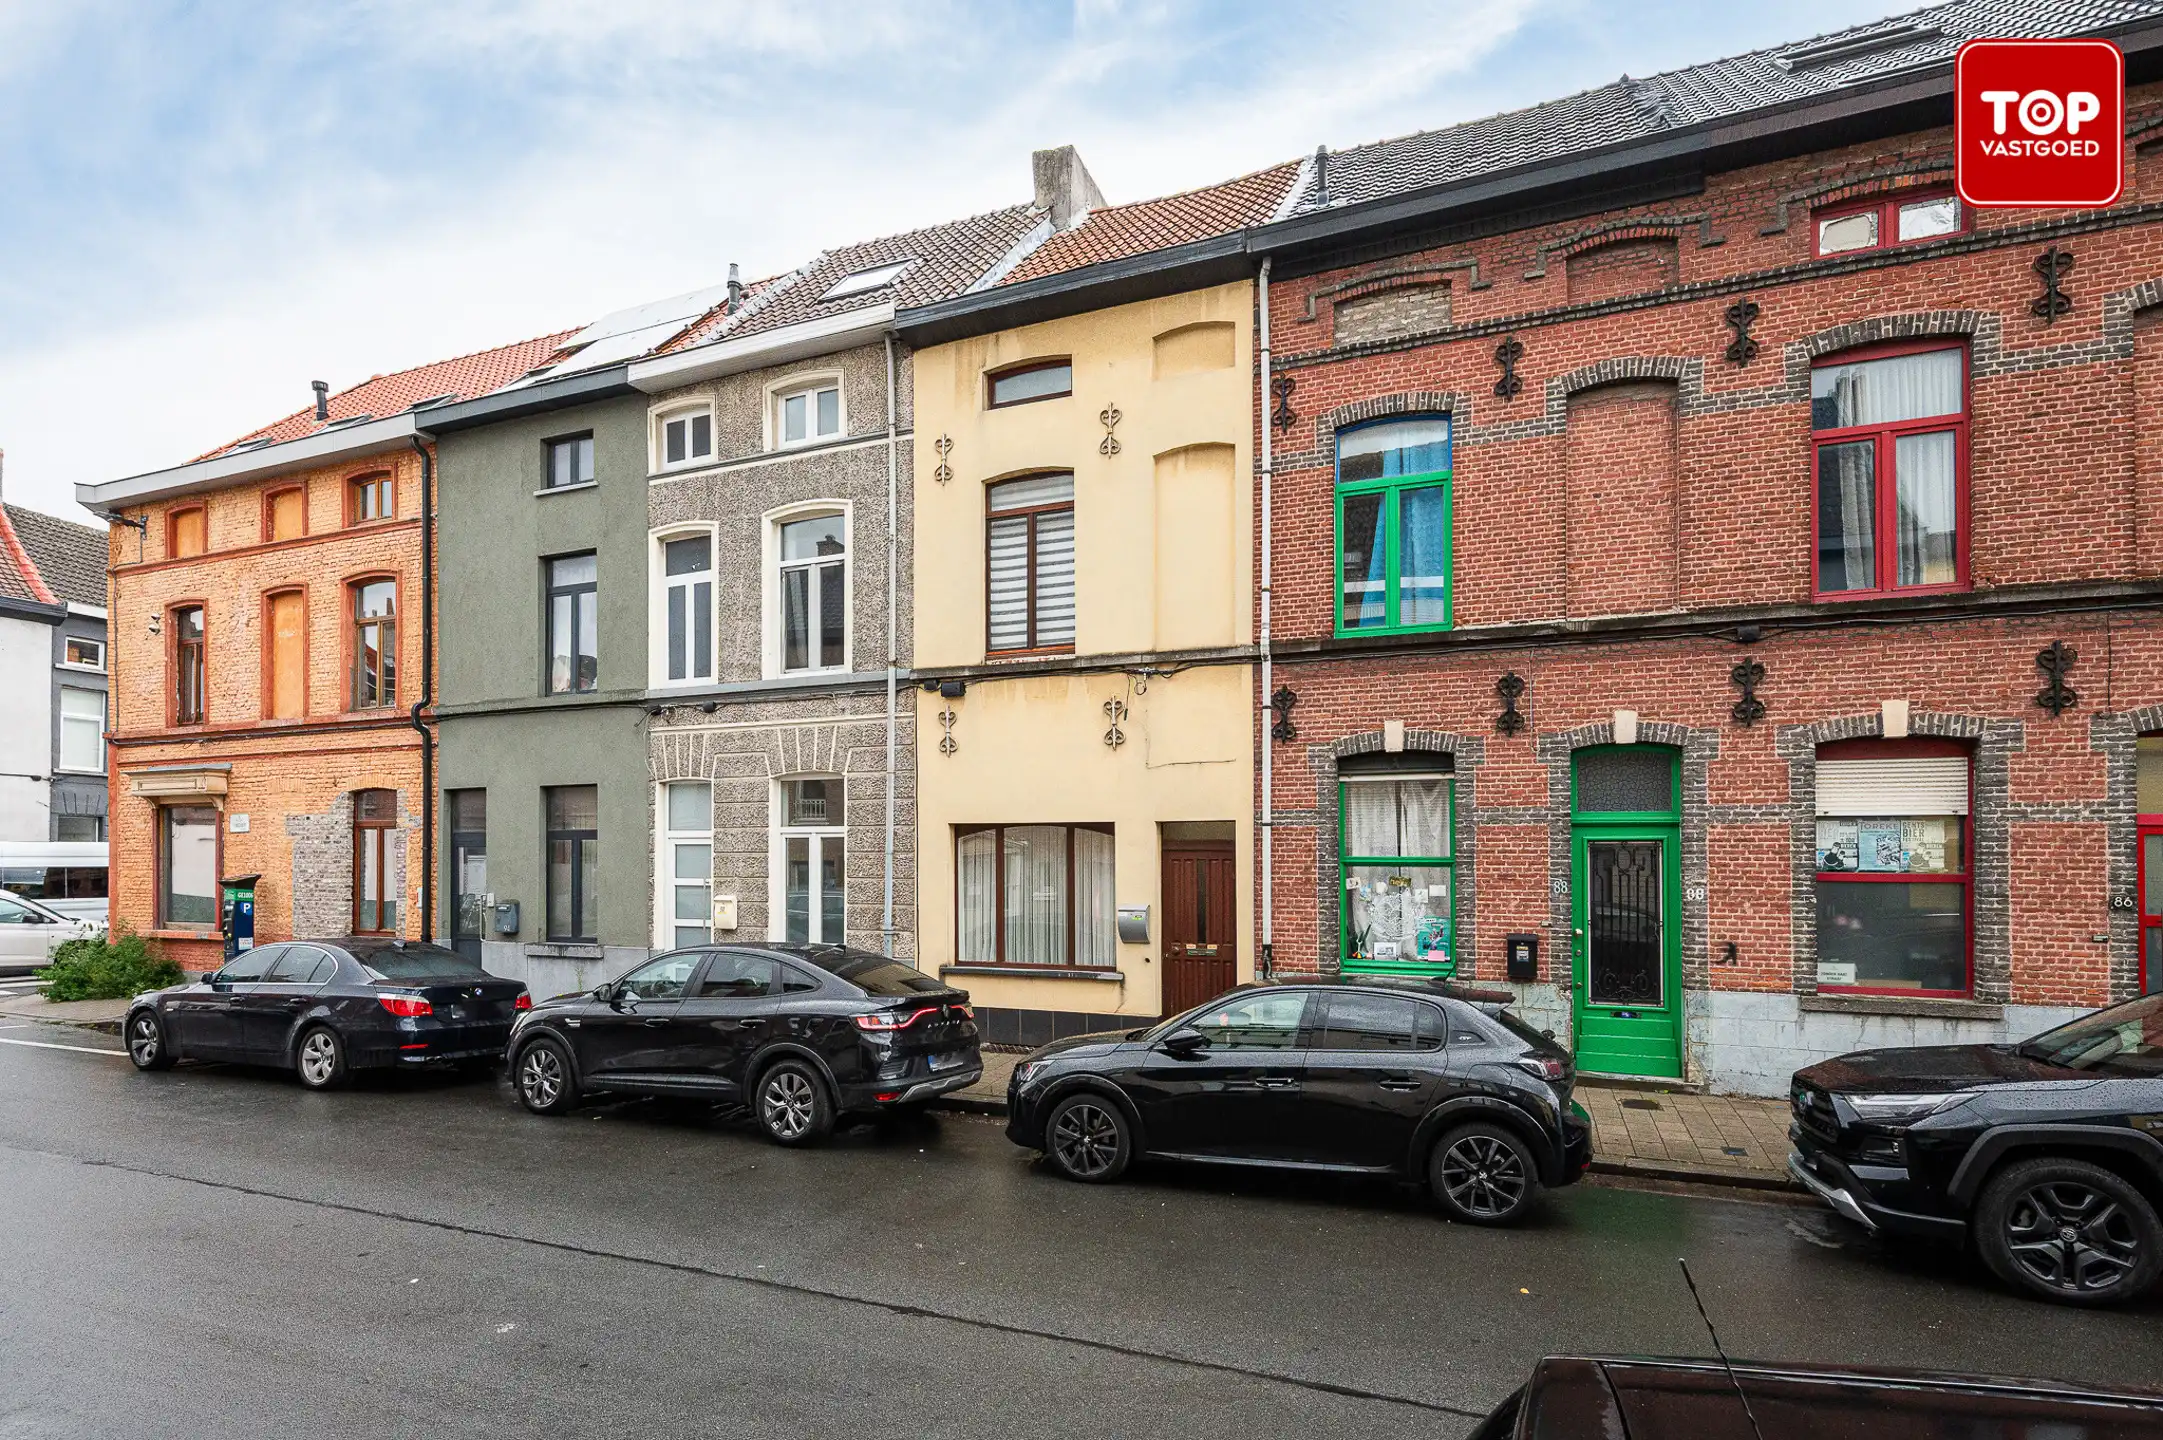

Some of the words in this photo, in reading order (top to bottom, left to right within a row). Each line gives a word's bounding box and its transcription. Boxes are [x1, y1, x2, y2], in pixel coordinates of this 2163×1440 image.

[1860, 821, 1899, 831] TOREKE
[1902, 821, 1925, 829] GENTS
[1902, 829, 1925, 837] BIER
[1553, 880, 1568, 894] 88
[2114, 896, 2133, 908] 86
[243, 902, 251, 914] P
